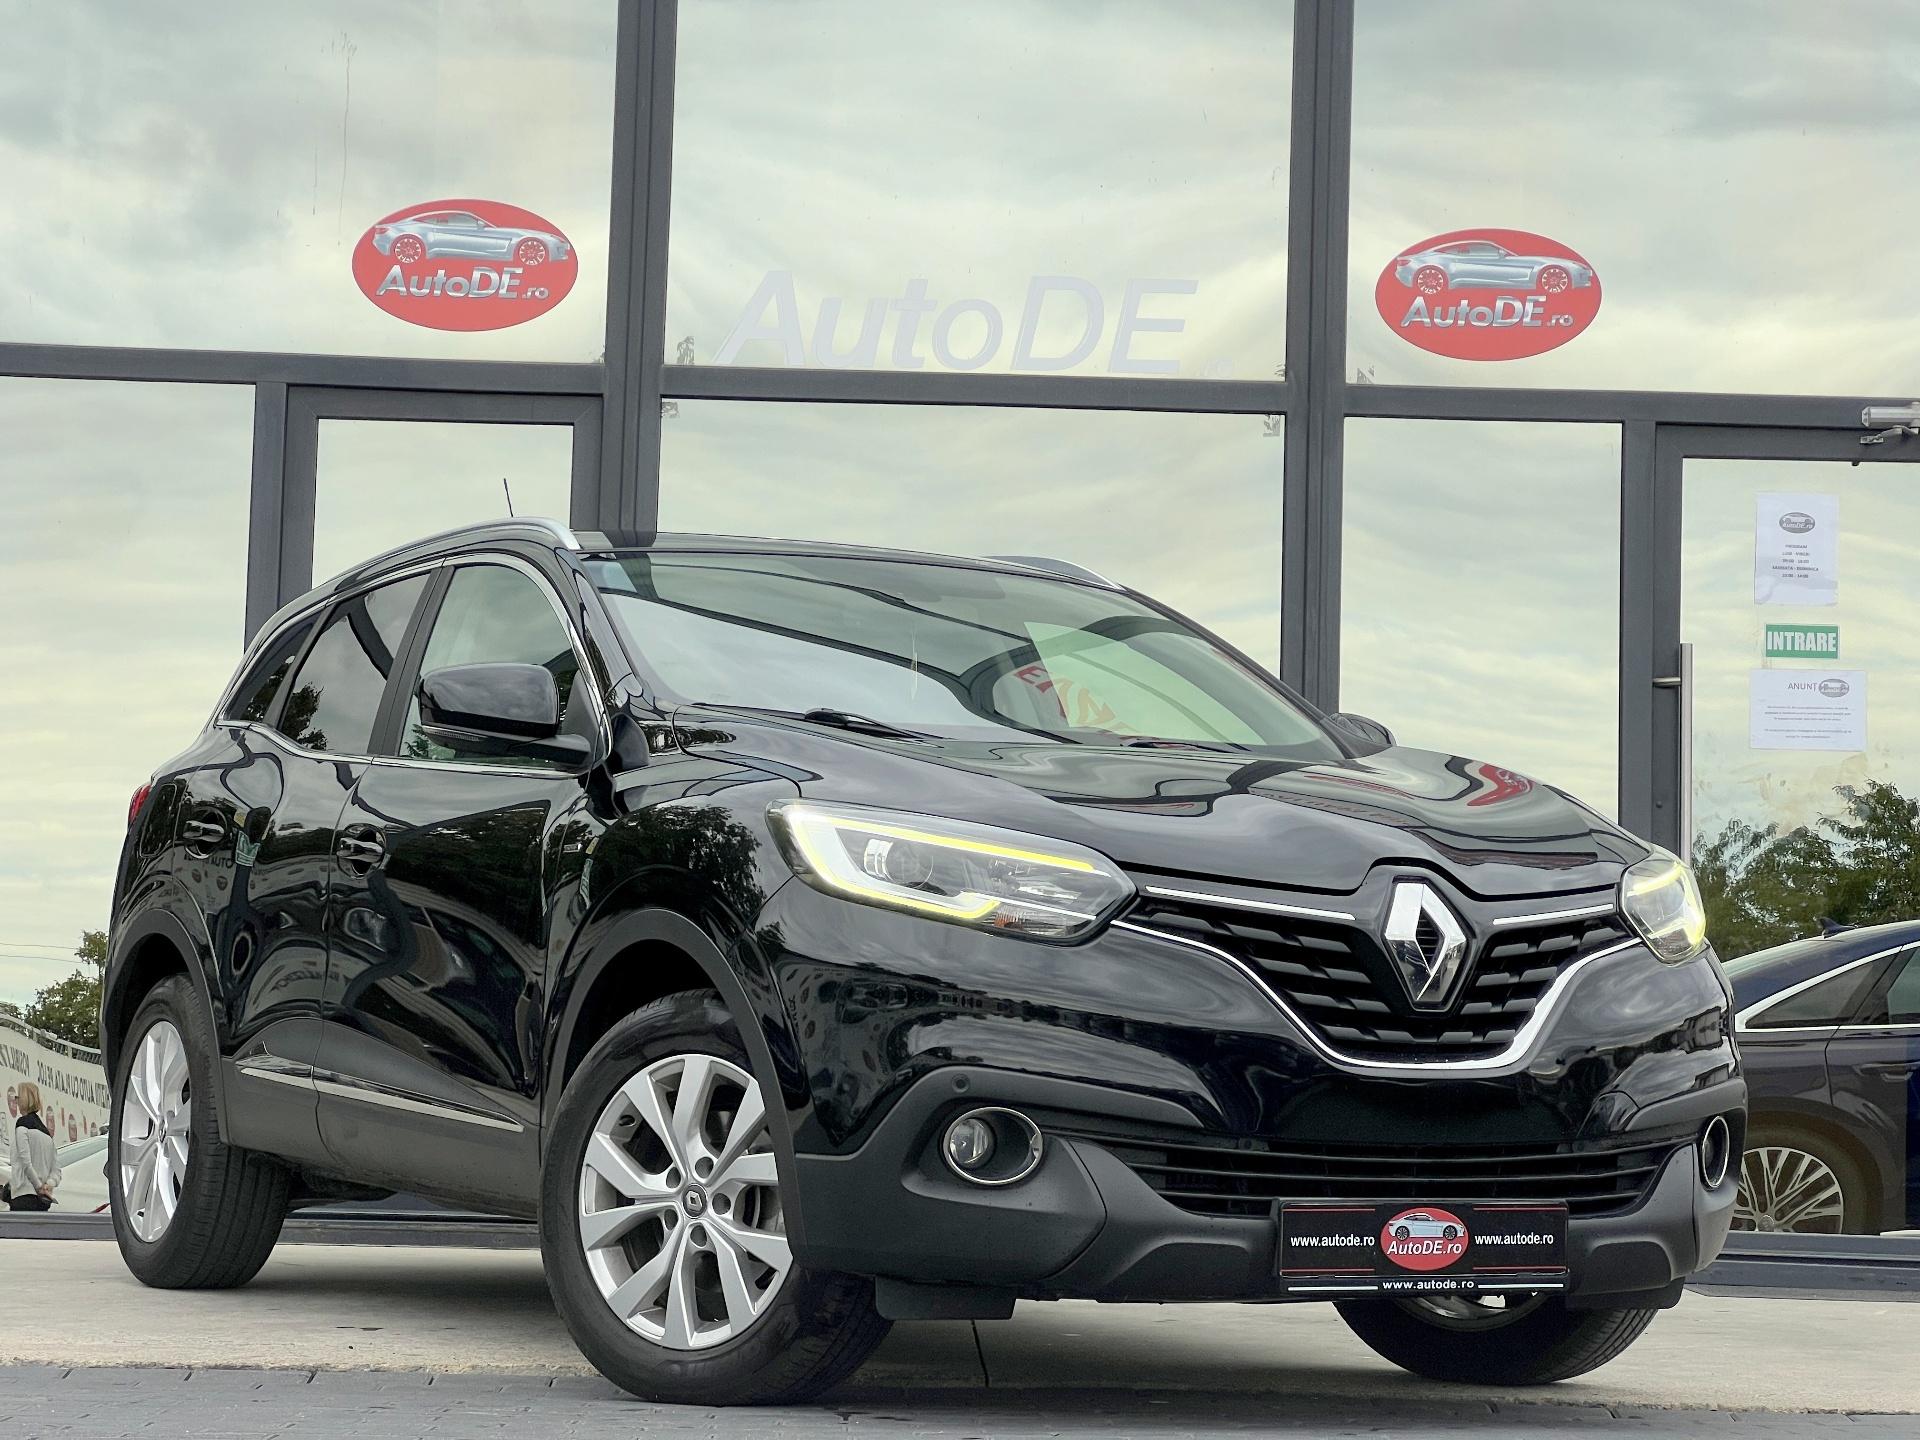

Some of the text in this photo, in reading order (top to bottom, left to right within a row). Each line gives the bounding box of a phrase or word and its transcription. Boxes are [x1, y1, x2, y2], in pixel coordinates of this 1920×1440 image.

[1767, 631, 1837, 652] INTRARE
[1290, 1234, 1375, 1247] www.autode.ro
[1474, 1232, 1554, 1246] www.autode.ro
[1386, 1240, 1462, 1256] AutoDE.ro
[1382, 1279, 1475, 1289] www.autode.ro
